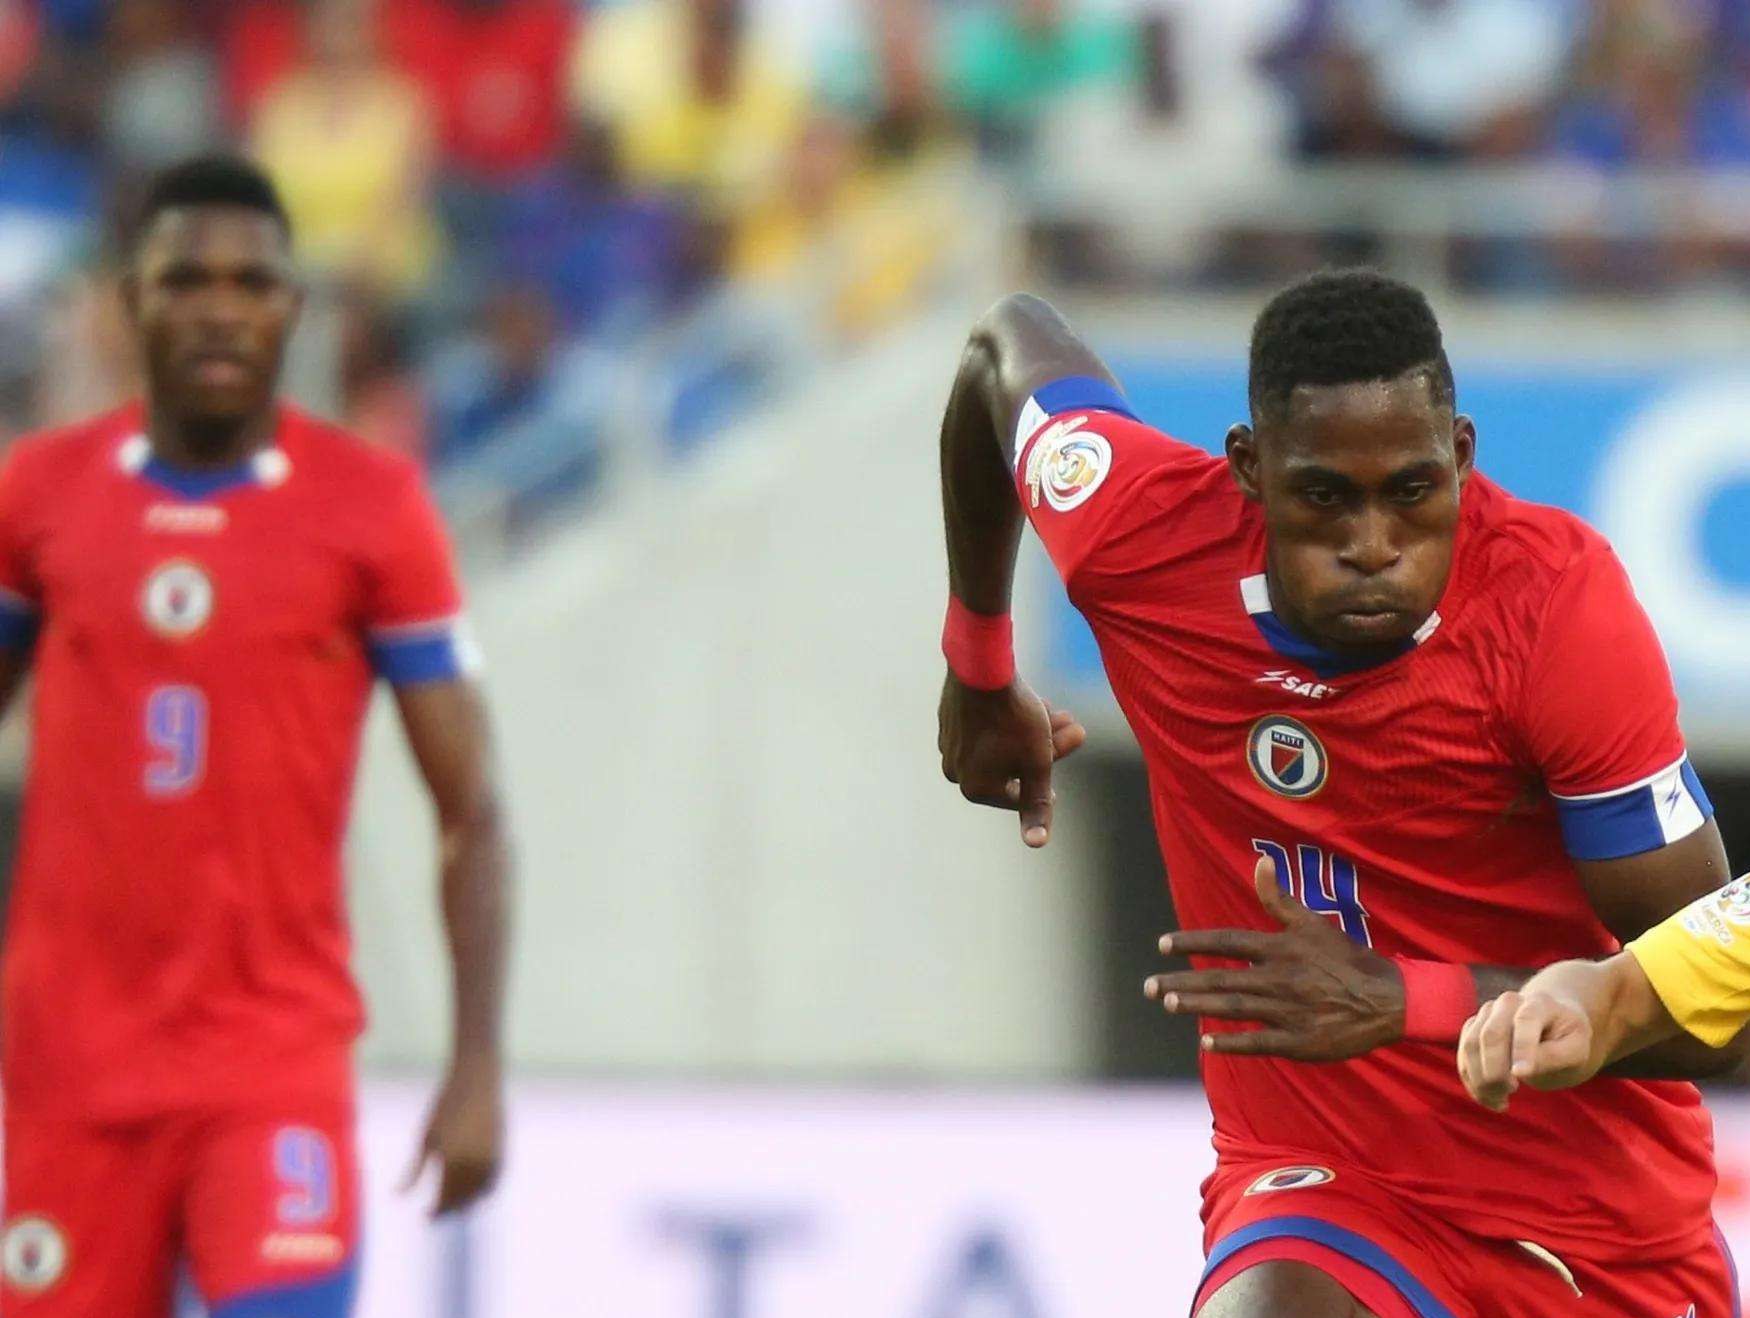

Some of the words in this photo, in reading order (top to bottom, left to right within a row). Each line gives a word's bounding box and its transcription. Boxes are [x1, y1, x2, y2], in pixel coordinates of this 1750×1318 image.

[1280, 675, 1338, 699] SAE
[145, 684, 209, 796] 9
[1251, 838, 1373, 950] 14
[274, 1126, 340, 1222] 9
